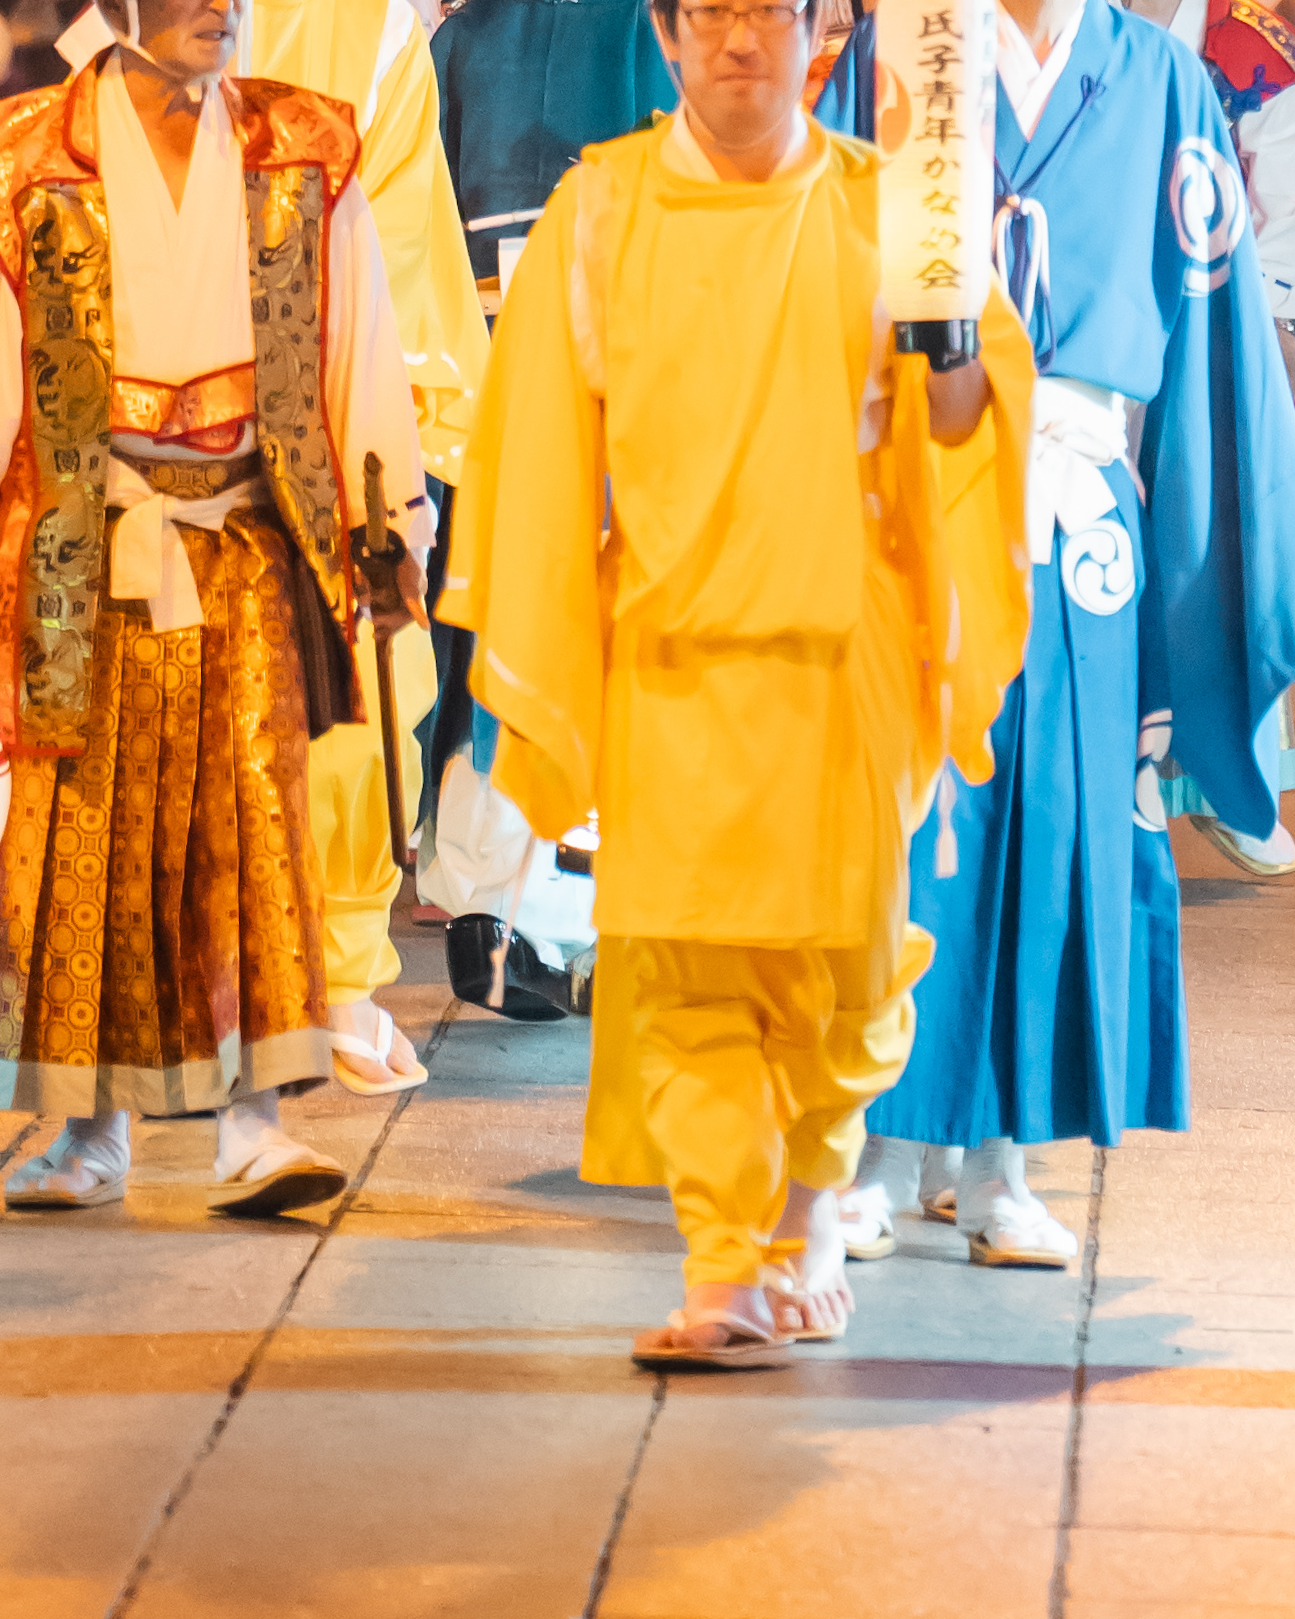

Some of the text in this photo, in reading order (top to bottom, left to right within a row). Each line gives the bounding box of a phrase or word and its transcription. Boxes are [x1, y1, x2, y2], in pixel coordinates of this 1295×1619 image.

[913, 9, 967, 291] 氏子青年かなめ会
